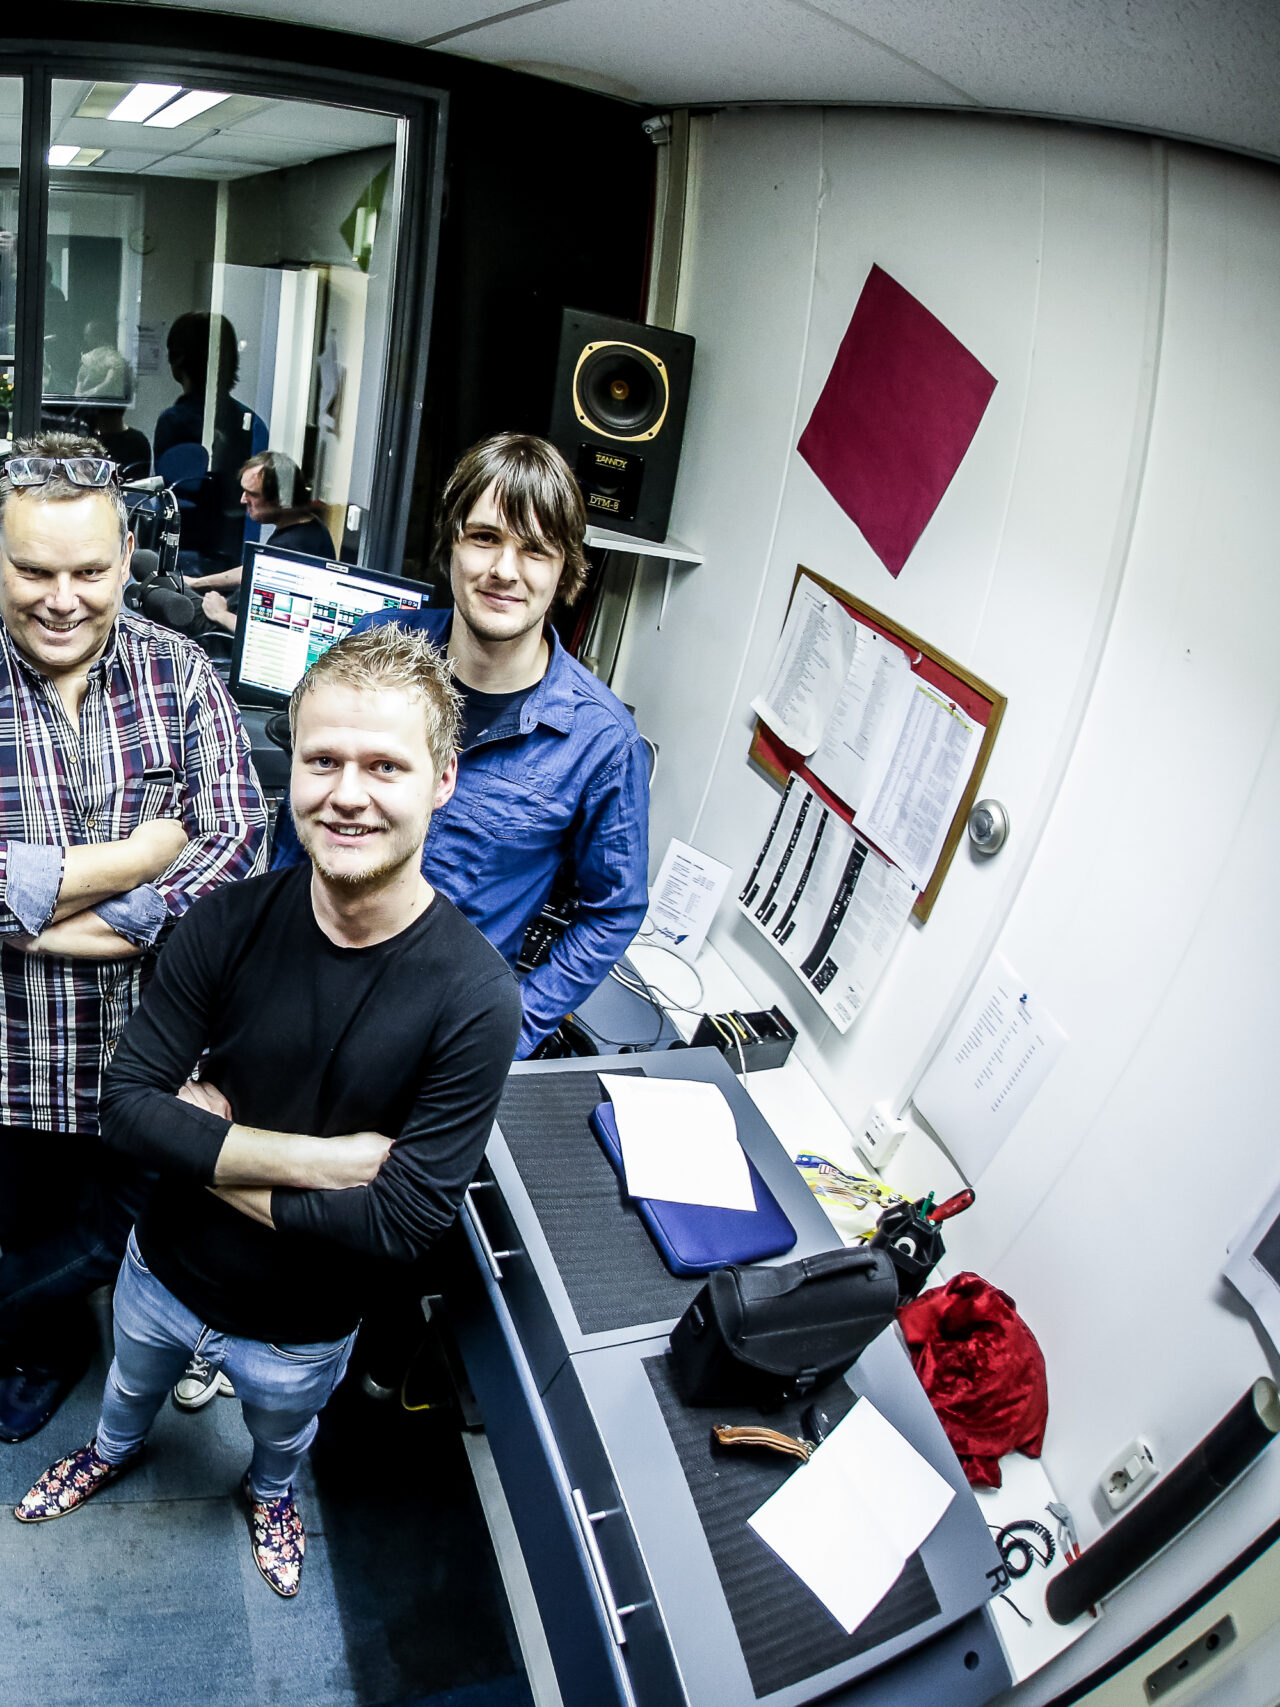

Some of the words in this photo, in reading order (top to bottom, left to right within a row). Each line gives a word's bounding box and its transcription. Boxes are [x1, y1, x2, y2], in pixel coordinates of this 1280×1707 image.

[595, 454, 628, 469] TANNOY
[589, 495, 620, 510] DTM-8
[985, 1563, 1009, 1593] R
